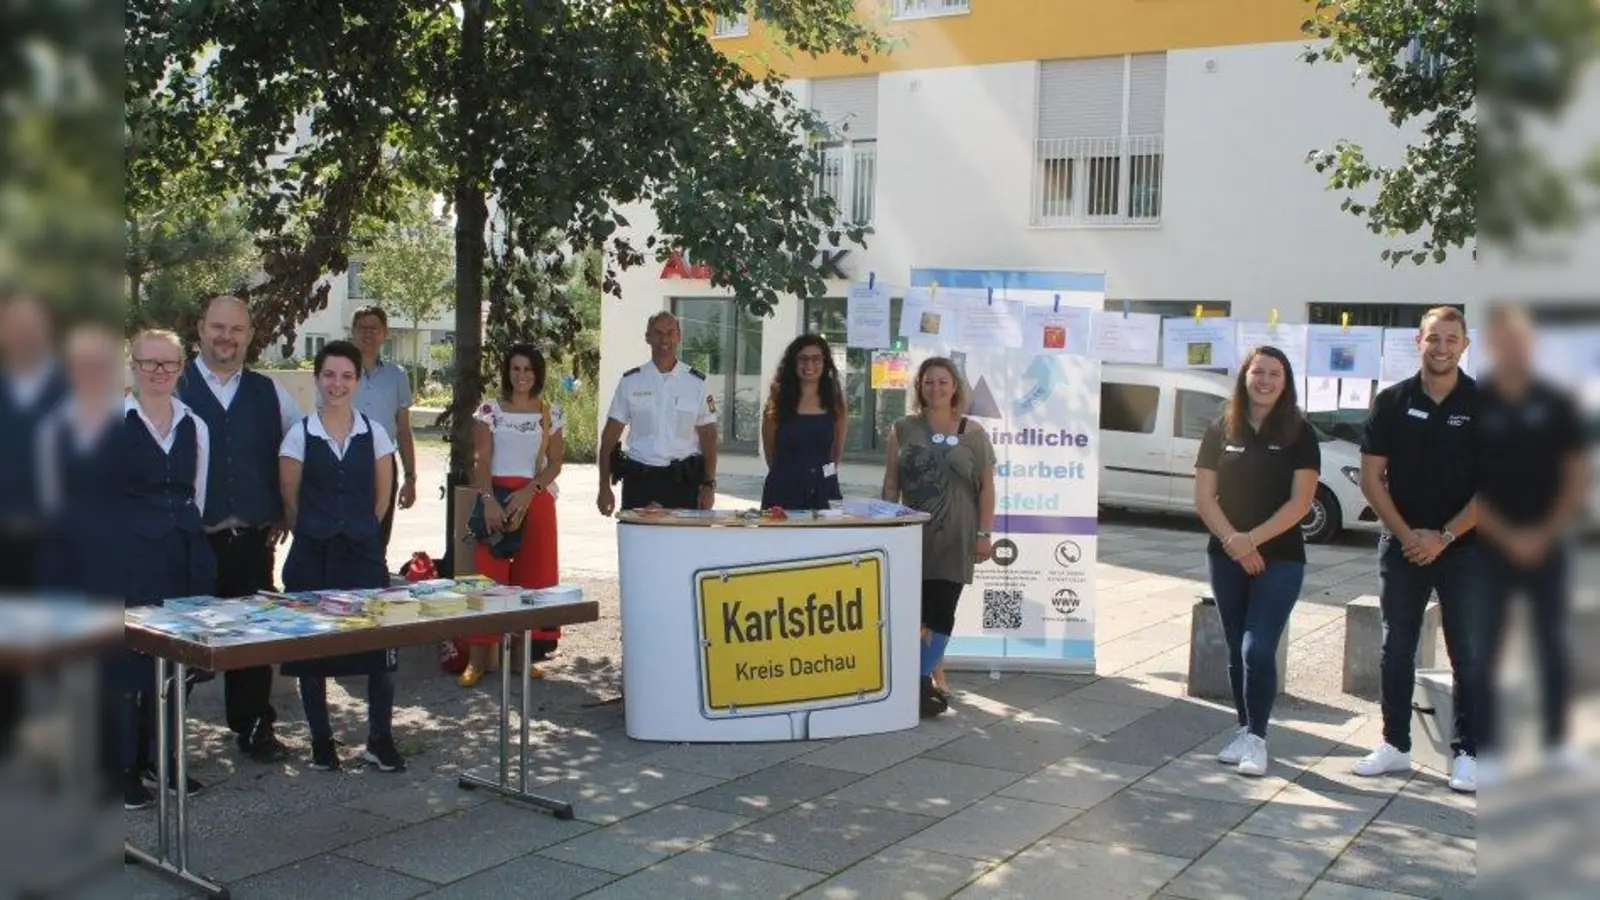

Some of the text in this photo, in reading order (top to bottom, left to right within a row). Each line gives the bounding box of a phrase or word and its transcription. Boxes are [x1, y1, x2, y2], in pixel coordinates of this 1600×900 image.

[989, 427, 1089, 447] indliche
[994, 460, 1085, 479] darbeit
[999, 493, 1061, 511] sfeld
[722, 587, 863, 644] Karlsfeld
[736, 654, 856, 681] Kreis Dachau
